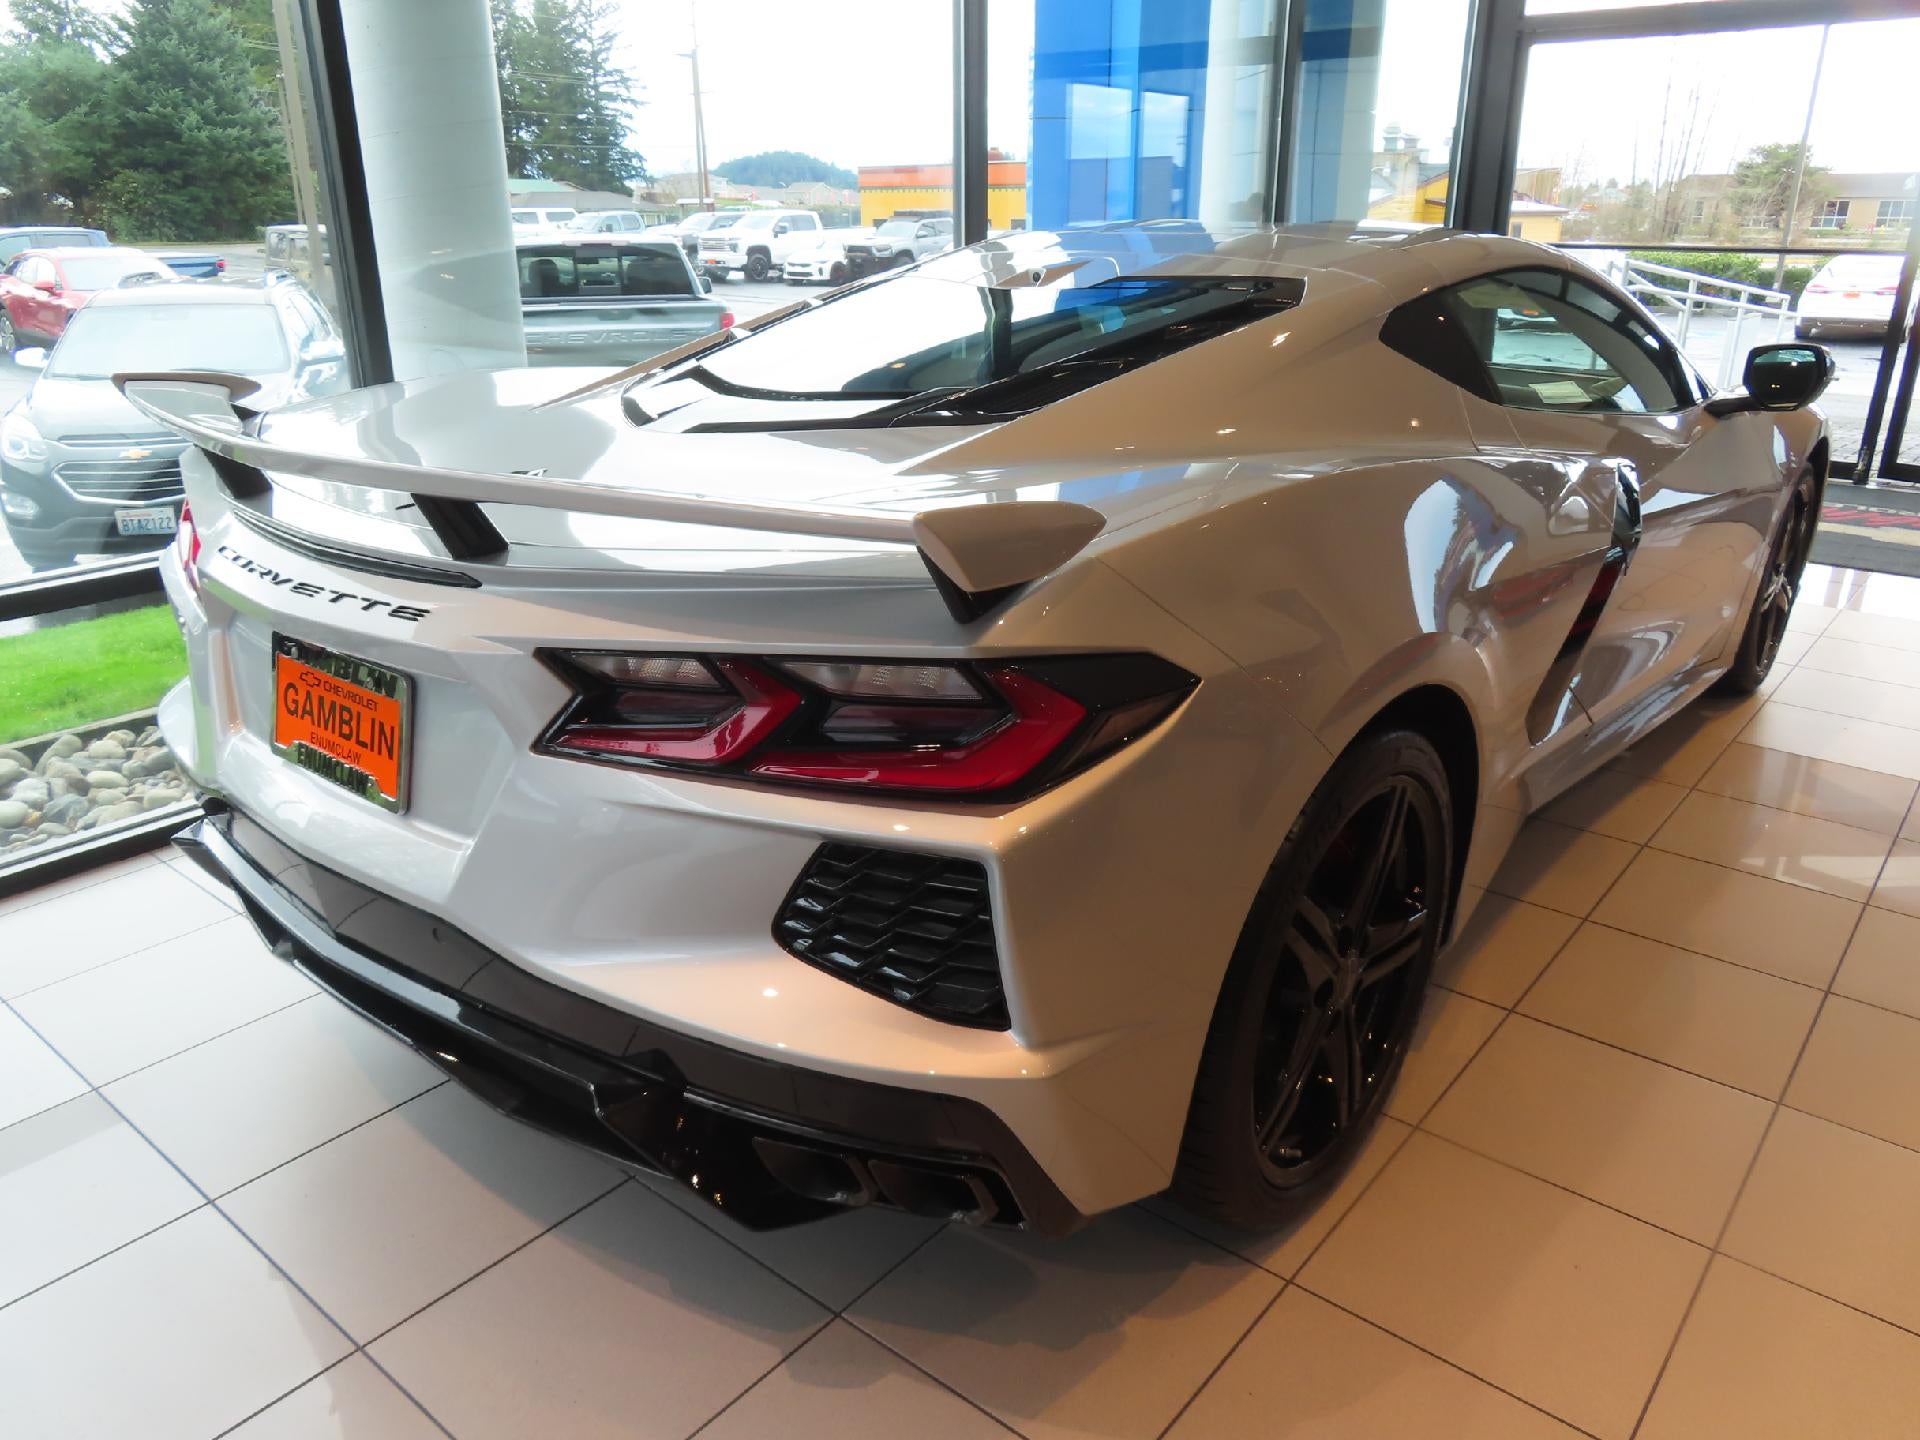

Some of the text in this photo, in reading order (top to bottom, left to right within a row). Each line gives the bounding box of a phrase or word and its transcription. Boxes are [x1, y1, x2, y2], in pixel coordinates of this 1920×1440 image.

[217, 545, 432, 622] CORVETTE
[283, 682, 395, 761] GAMBLIN
[323, 680, 379, 712] CHEVROLET
[310, 732, 362, 766] ENUMCLAW
